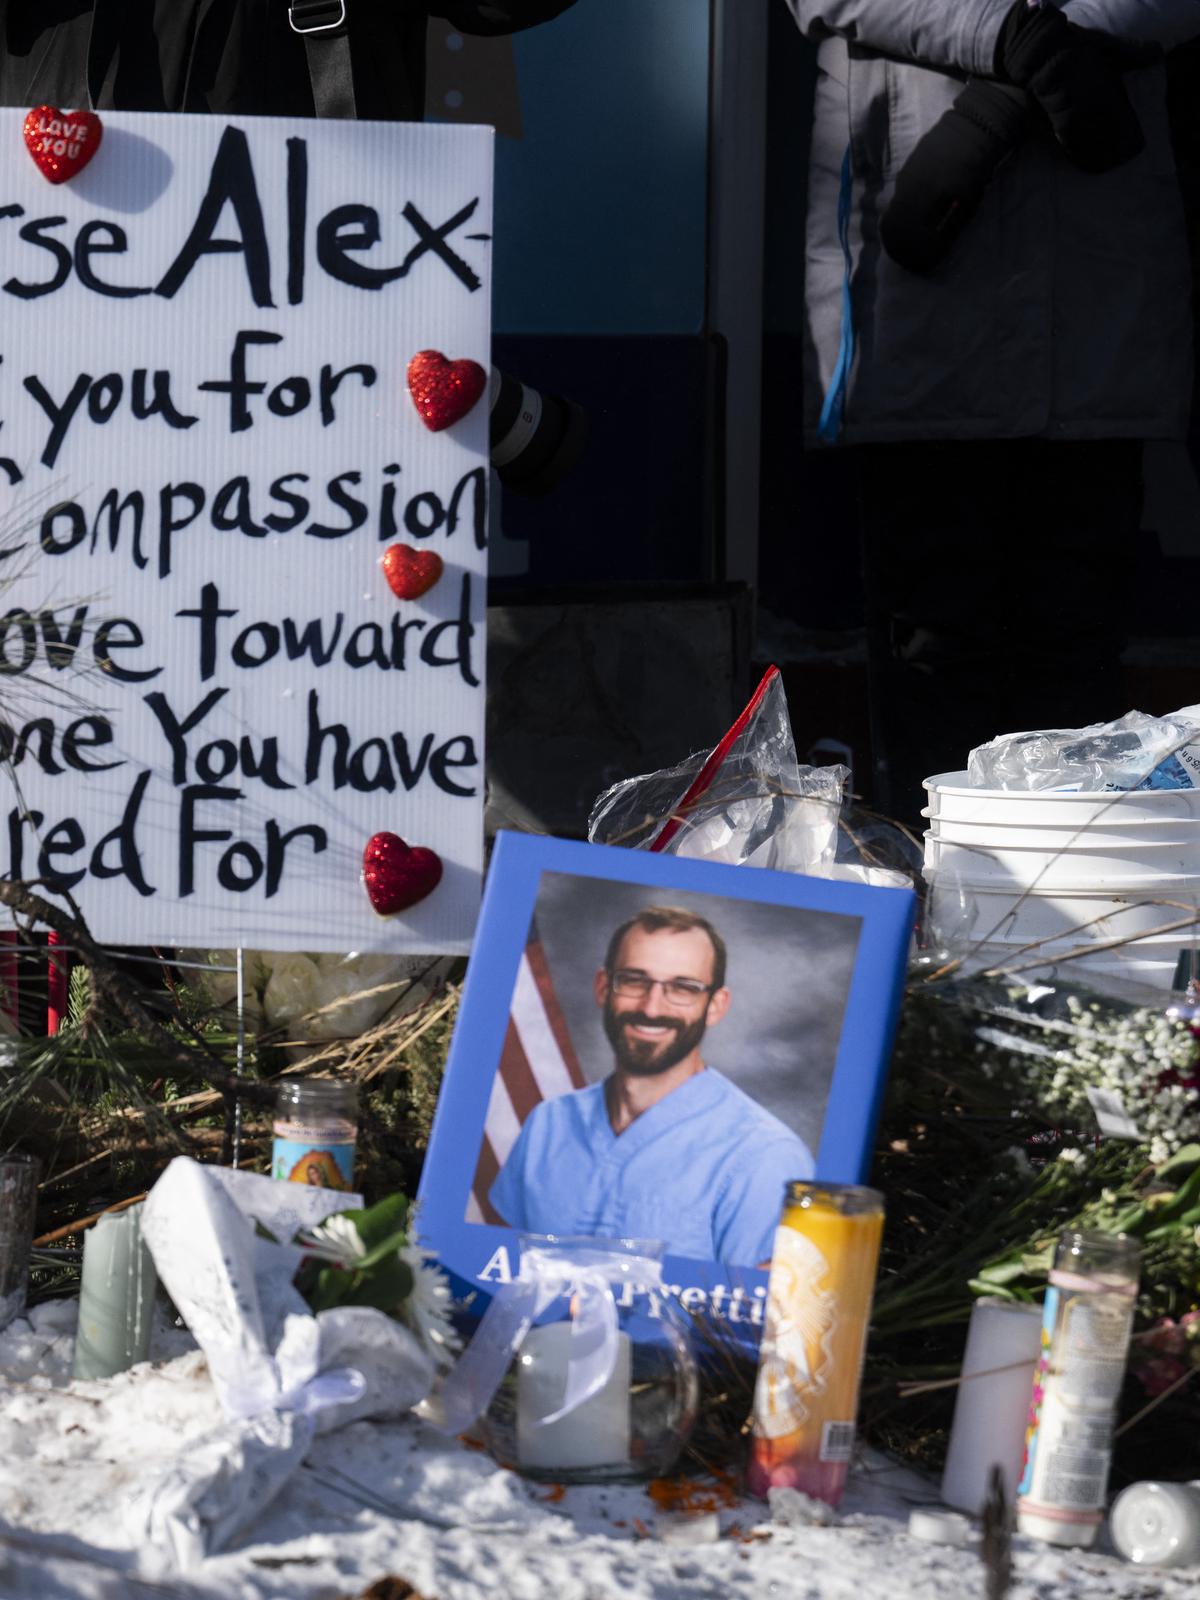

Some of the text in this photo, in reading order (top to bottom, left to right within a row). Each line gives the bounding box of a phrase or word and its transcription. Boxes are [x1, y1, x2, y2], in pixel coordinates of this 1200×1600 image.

[39, 117, 88, 142] LOVE
[42, 137, 81, 159] YOU
[23, 369, 199, 469] you
[175, 572, 479, 687] toward
[142, 687, 297, 789] You
[305, 689, 478, 797] have
[179, 783, 328, 898] For
